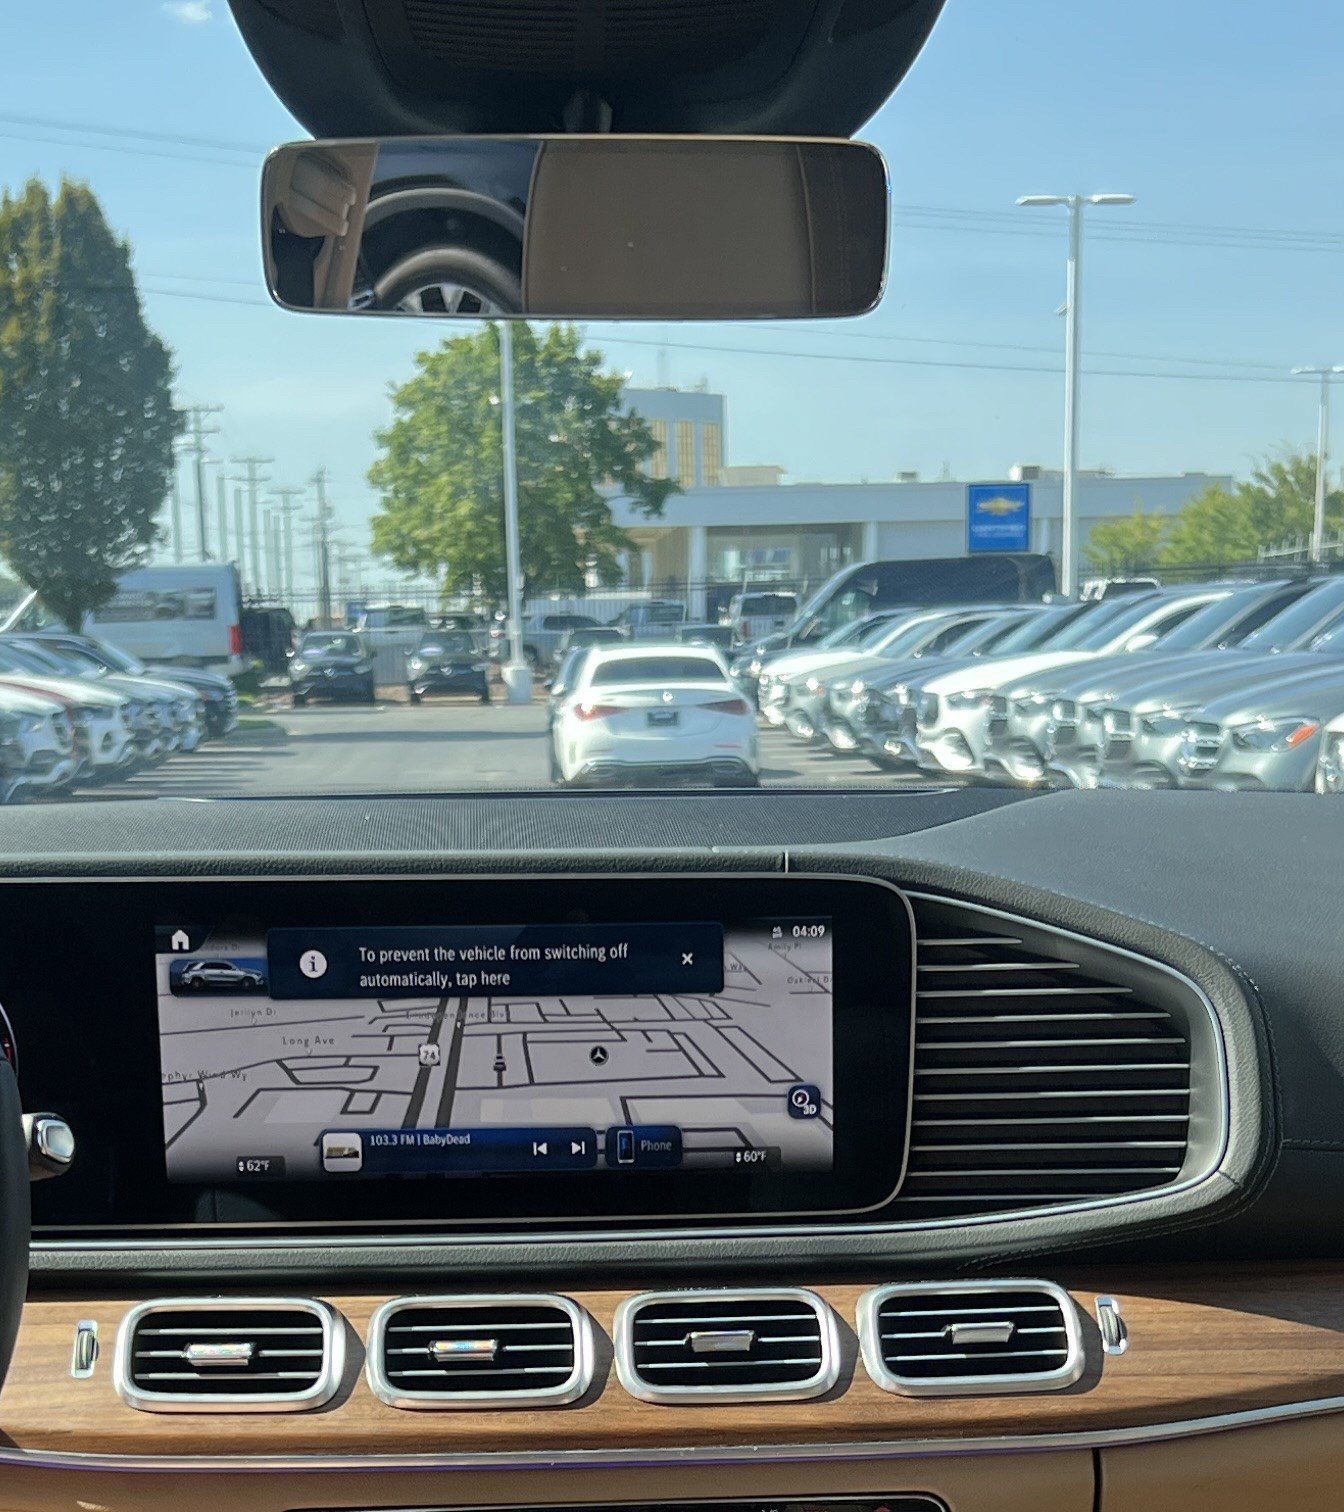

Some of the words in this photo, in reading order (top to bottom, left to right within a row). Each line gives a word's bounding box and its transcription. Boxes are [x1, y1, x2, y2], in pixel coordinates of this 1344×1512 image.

[792, 925, 825, 938] 04:09
[359, 947, 375, 962] To
[379, 948, 430, 964] prevent
[434, 946, 455, 961] the
[459, 946, 506, 961] vehicle
[510, 944, 543, 960] from
[545, 943, 606, 962] switching
[610, 942, 628, 959] off
[360, 971, 453, 989] automatically,
[456, 972, 477, 987] tap
[481, 970, 511, 985] here
[282, 1035, 310, 1047] Long
[314, 1035, 335, 1046] Ave
[422, 1050, 436, 1061] 74
[370, 1134, 397, 1146] 103.3
[400, 1134, 415, 1146] FM
[641, 1139, 672, 1151] Phone
[743, 1150, 767, 1162] 60°F
[246, 1160, 270, 1172] 62°F
